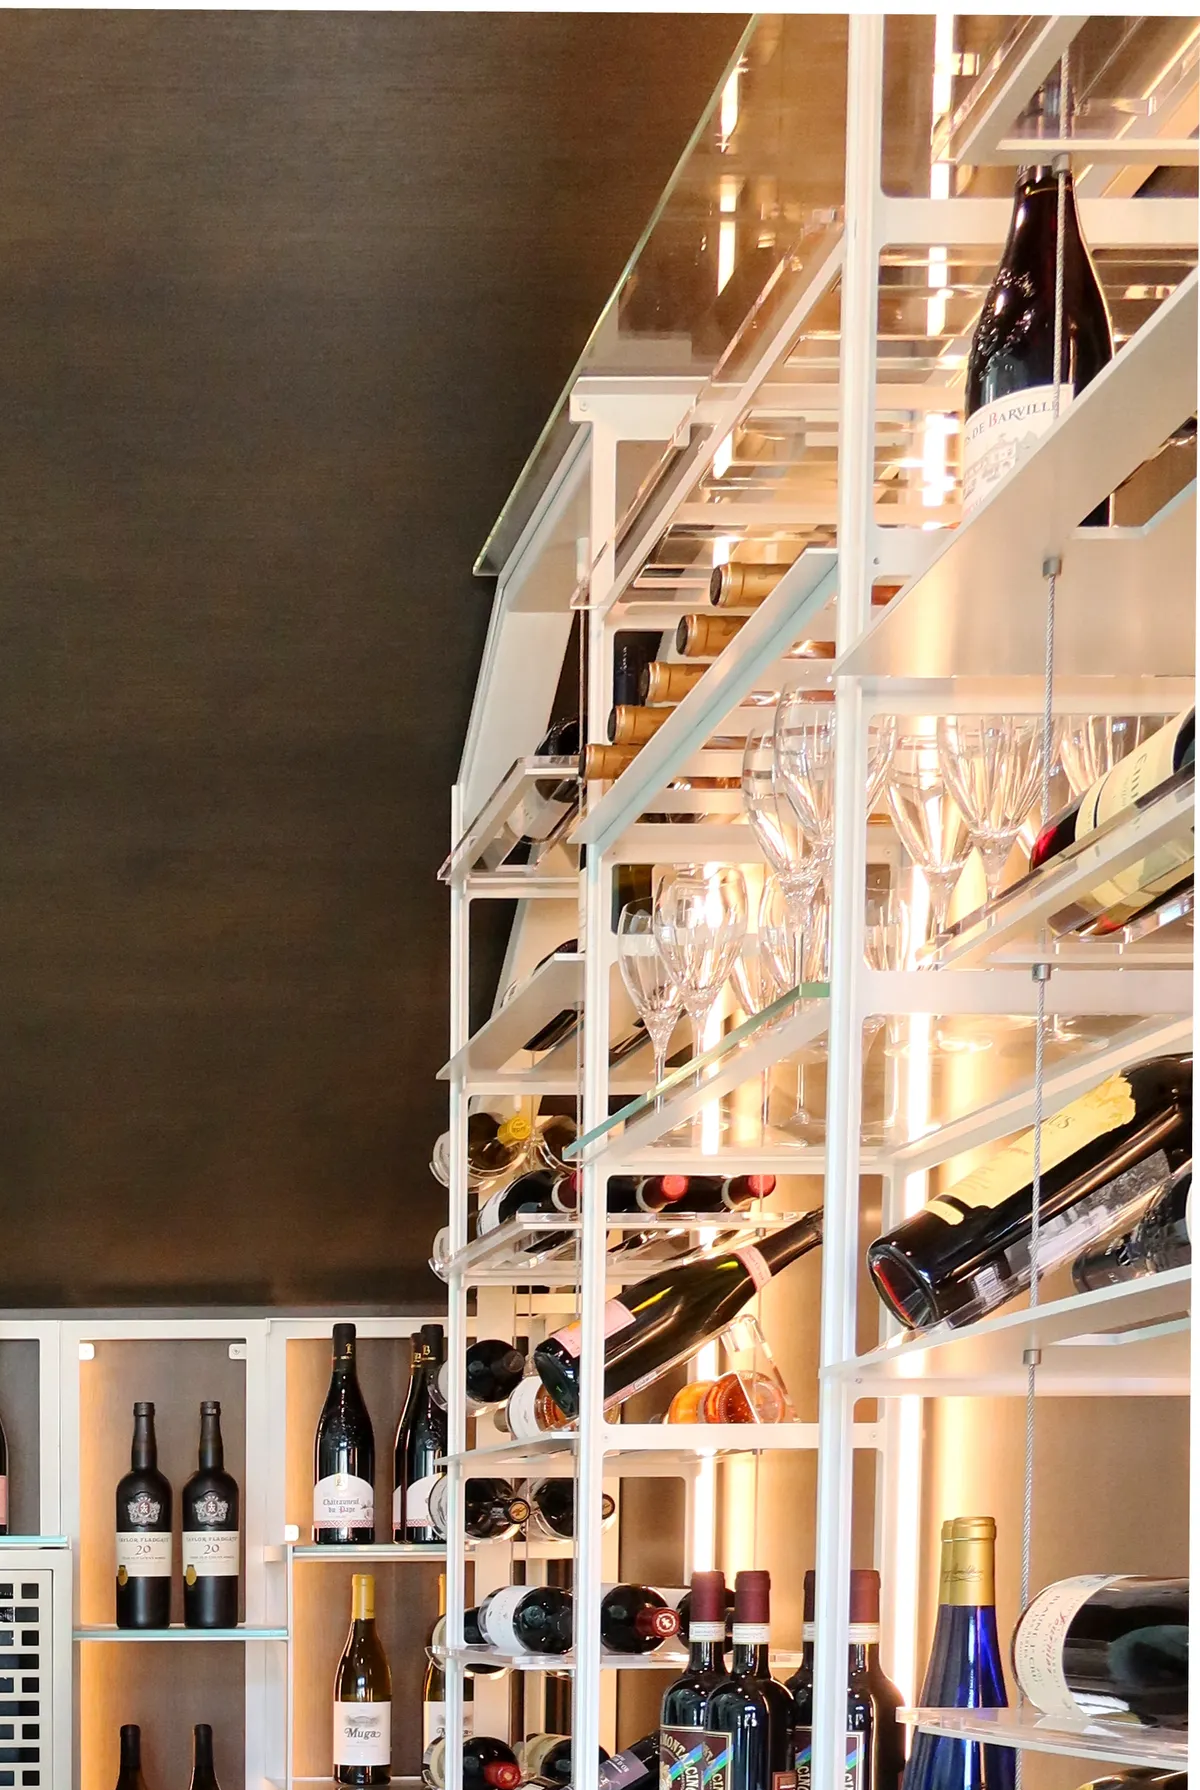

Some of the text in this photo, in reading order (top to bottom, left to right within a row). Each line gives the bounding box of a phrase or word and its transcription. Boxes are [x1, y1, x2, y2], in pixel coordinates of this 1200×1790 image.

[135, 1545, 151, 1556] 20
[204, 1544, 220, 1555] 20
[344, 1727, 381, 1740] Muga
